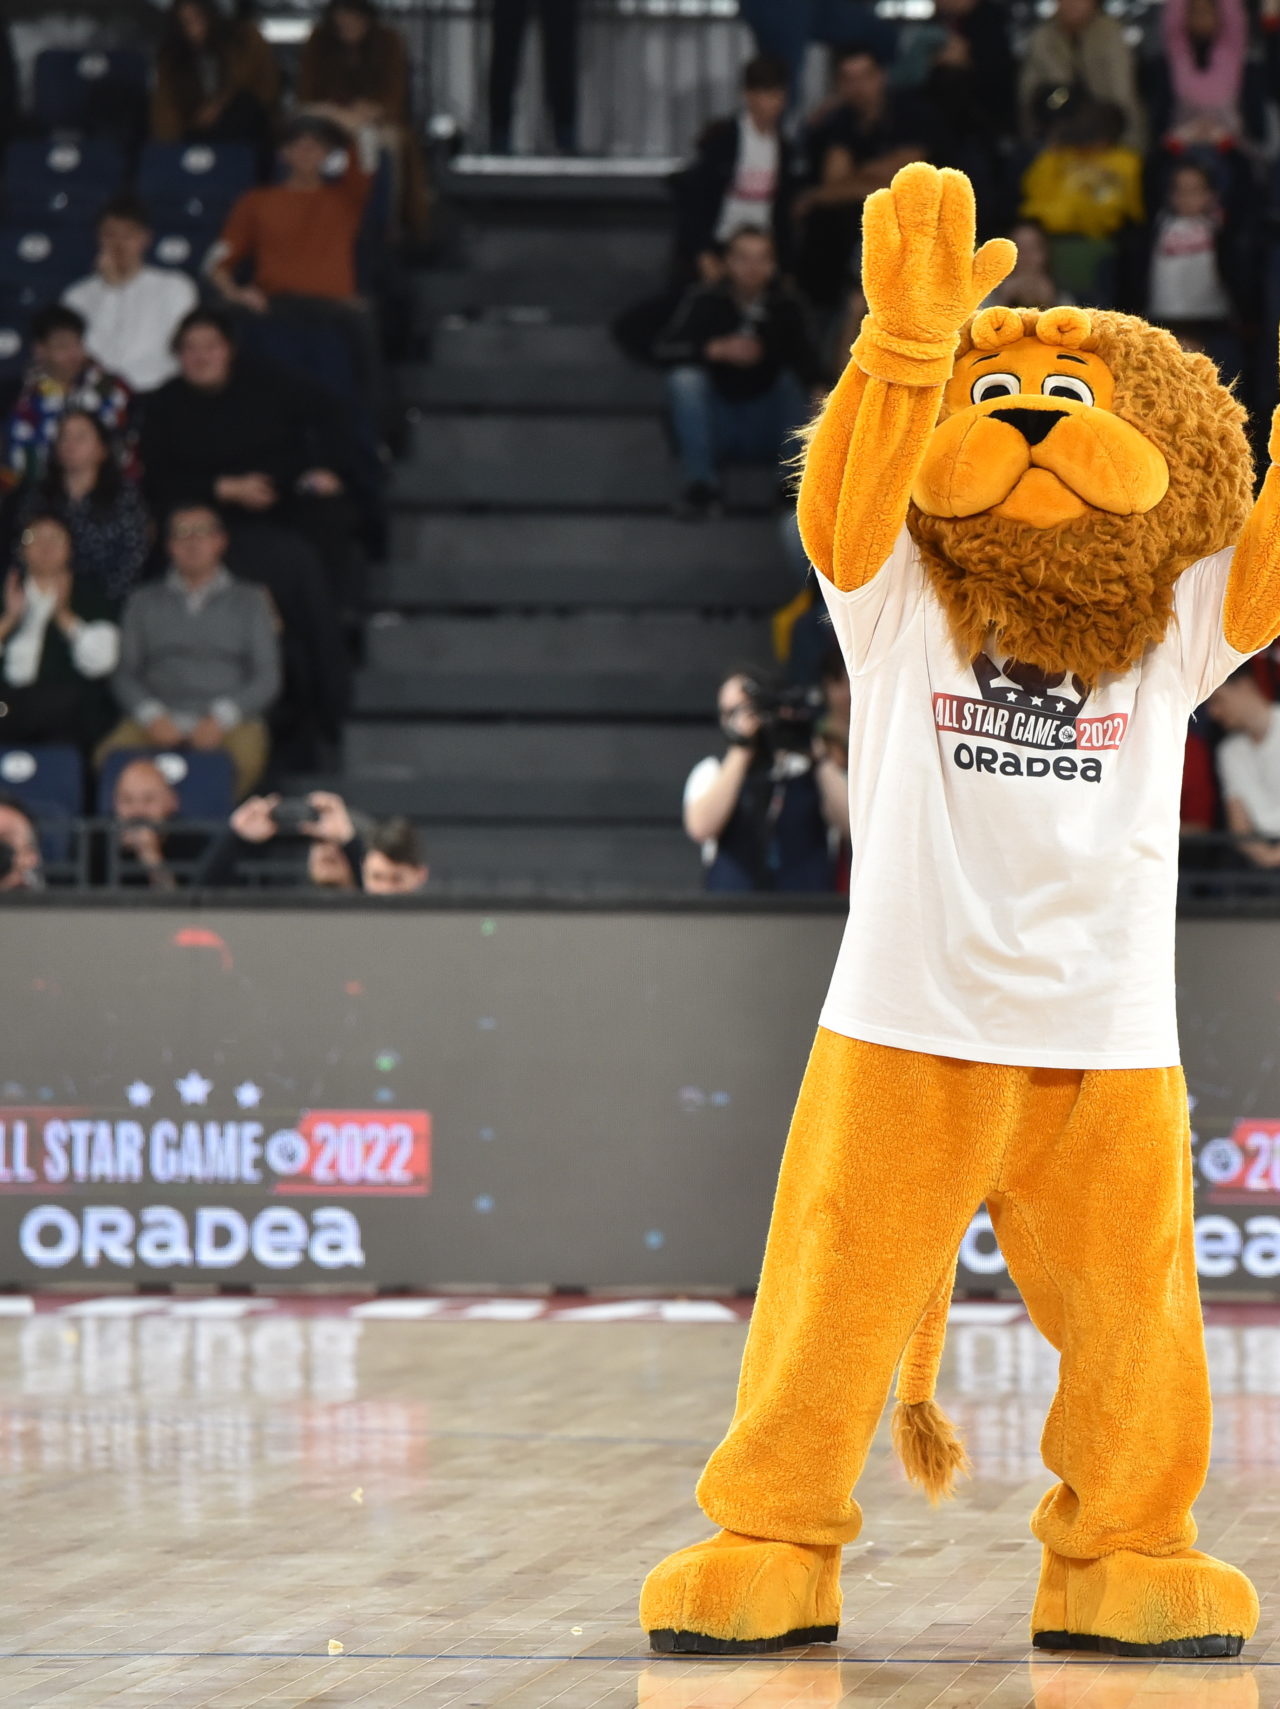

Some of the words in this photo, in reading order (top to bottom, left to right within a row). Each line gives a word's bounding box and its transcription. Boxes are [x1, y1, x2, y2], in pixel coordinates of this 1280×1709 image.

[935, 698, 959, 728] ALL
[961, 702, 1009, 736] STAR
[1010, 712, 1060, 747] GAME
[1079, 717, 1124, 747] 2022
[43, 1118, 145, 1183] STAR
[149, 1119, 265, 1184] GAME
[310, 1121, 415, 1185] 2022
